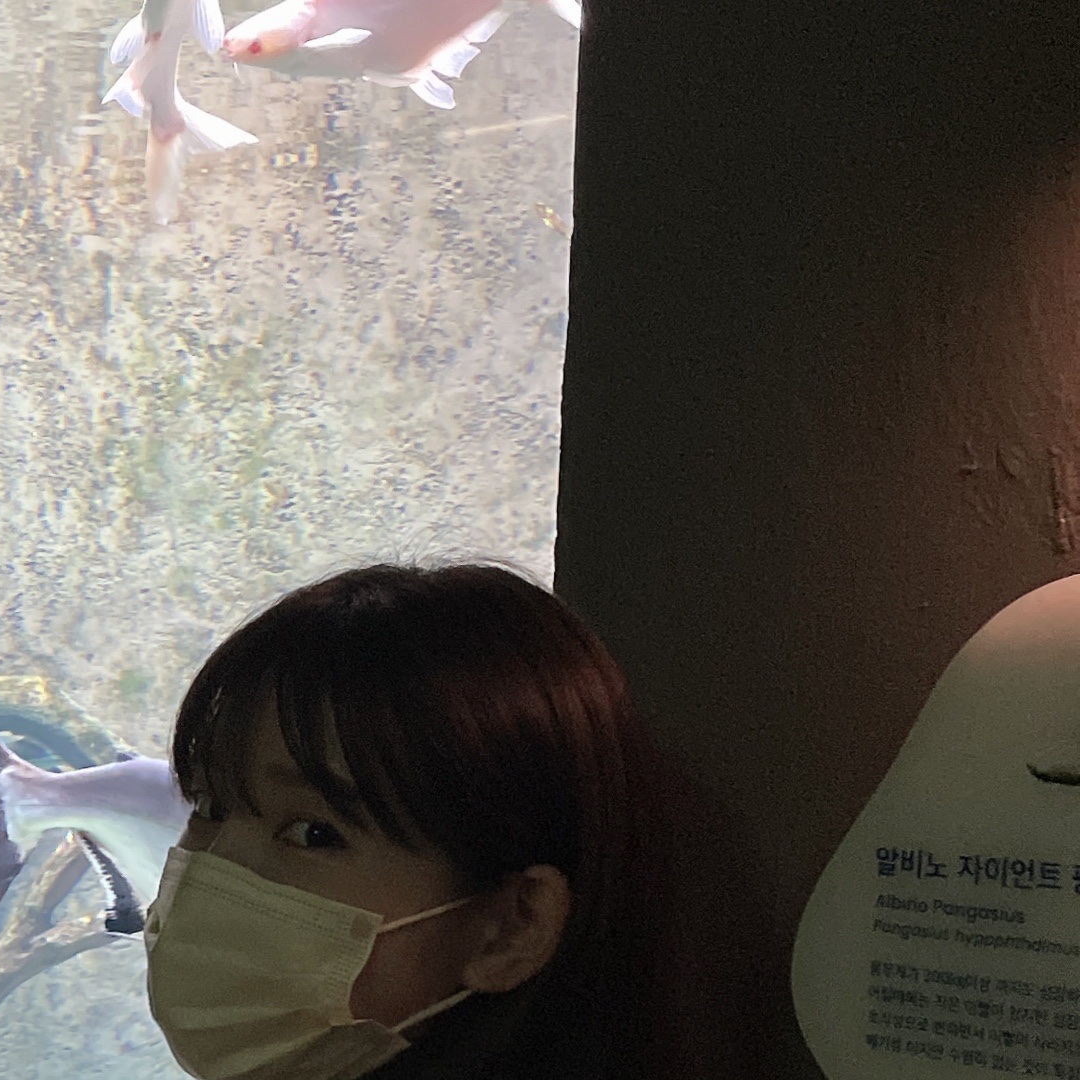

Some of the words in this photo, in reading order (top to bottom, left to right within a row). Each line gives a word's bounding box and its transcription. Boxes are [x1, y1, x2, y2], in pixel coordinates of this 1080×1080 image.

[876, 847, 948, 879] 알비노
[957, 855, 1062, 889] 자이언트
[875, 894, 928, 913] Albino
[933, 899, 1025, 924] Pangasius
[873, 918, 949, 940] Pangasius
